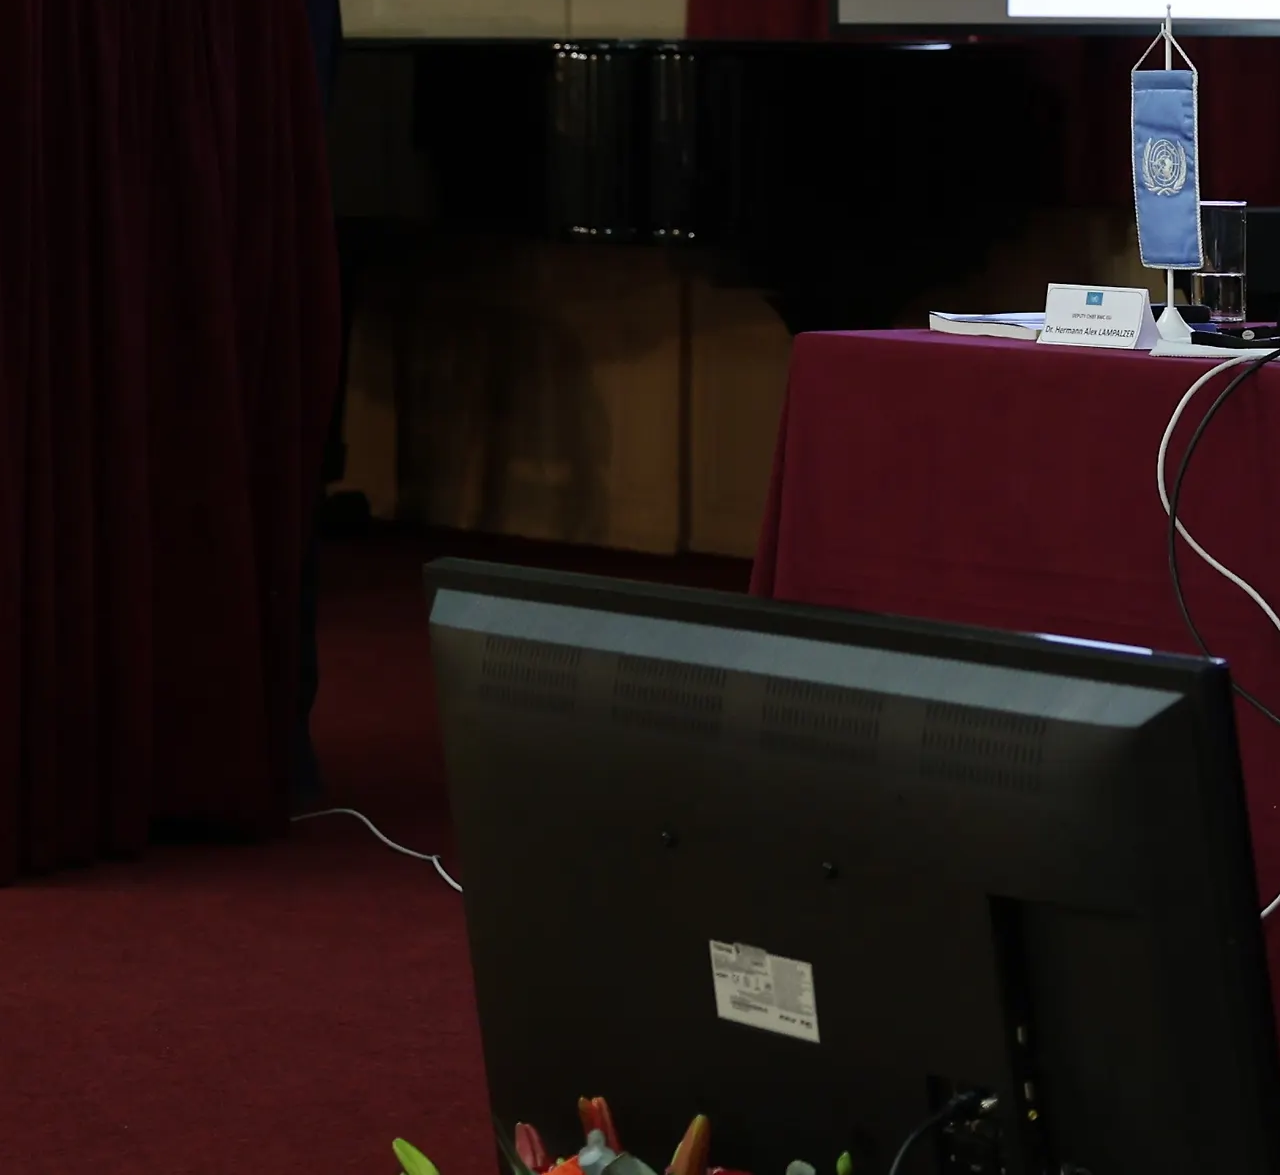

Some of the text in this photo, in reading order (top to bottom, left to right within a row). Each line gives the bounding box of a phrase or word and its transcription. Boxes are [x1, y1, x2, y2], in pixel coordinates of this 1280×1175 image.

[1045, 325, 1135, 338] Dr. Hermann Alex LAMPALZER
